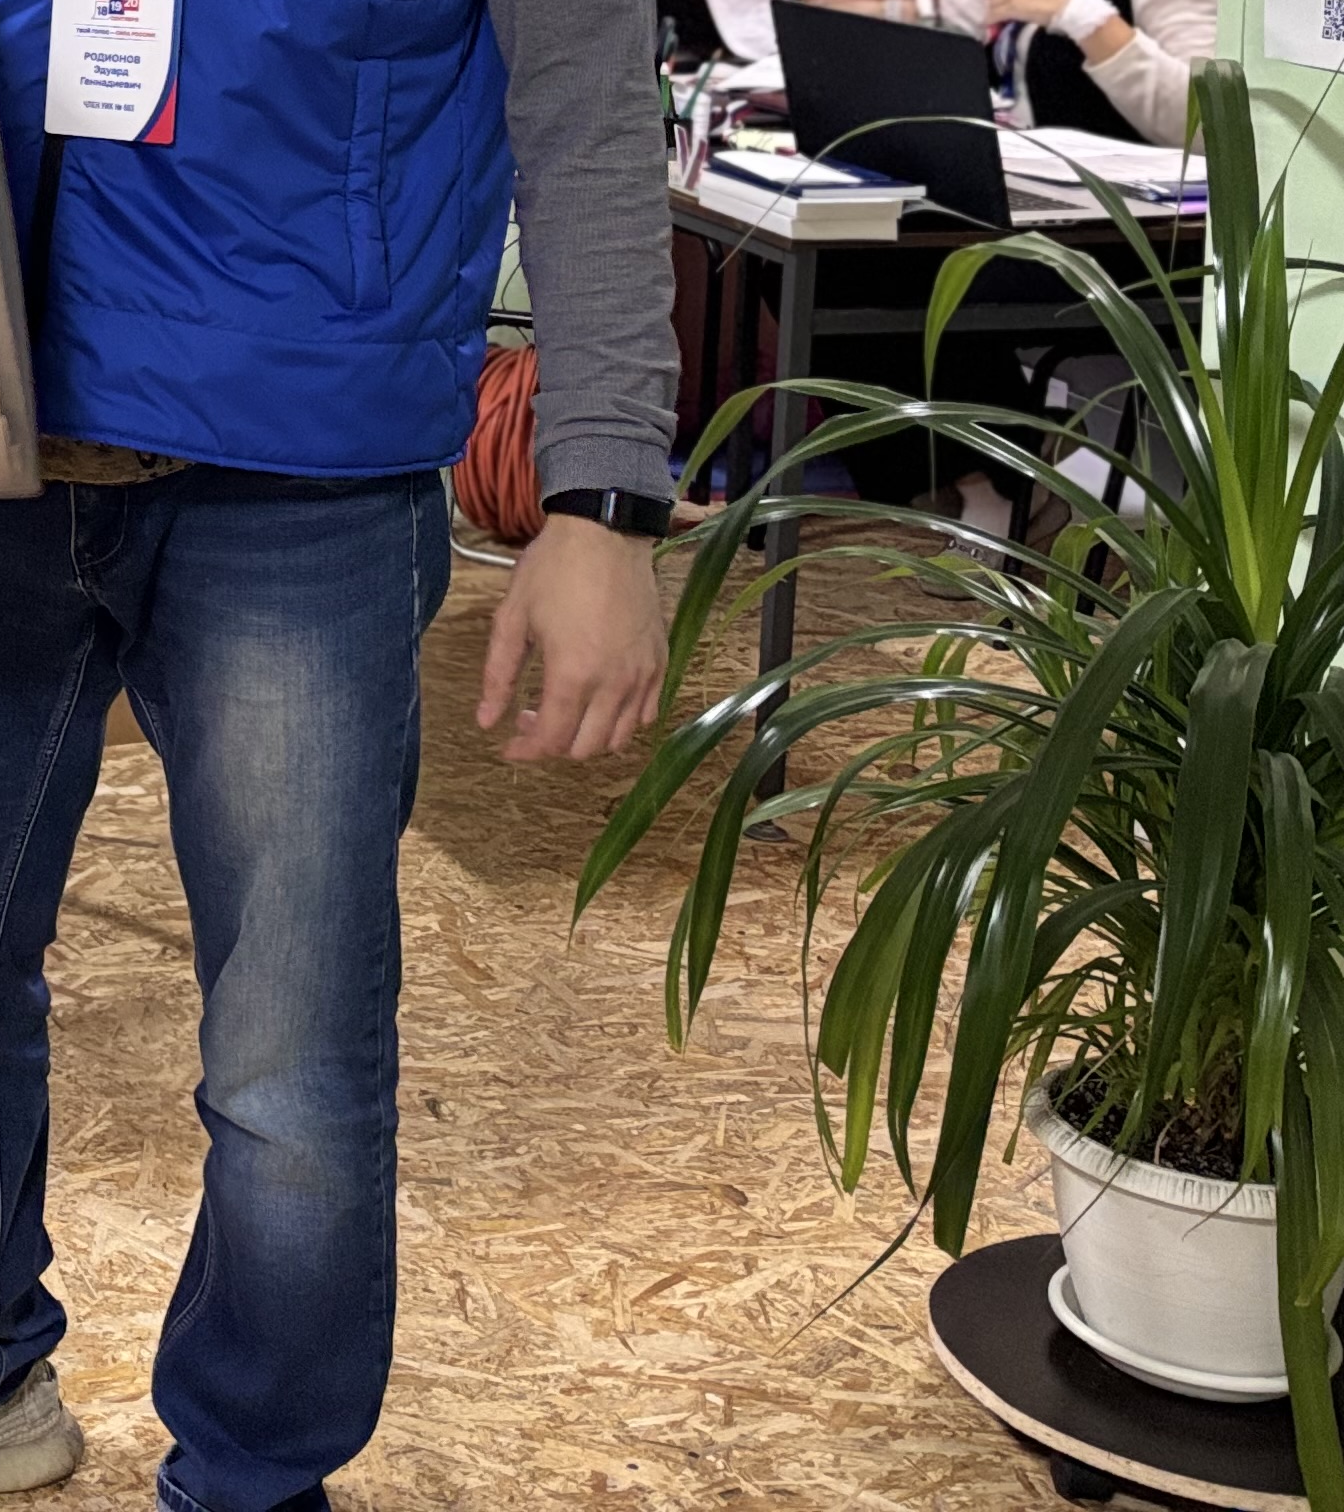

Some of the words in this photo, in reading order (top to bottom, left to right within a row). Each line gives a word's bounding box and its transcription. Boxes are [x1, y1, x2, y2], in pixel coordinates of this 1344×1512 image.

[97, 5, 109, 17] 18
[111, 0, 123, 13] 19
[83, 51, 141, 64] РОДИОНОВ
[93, 65, 129, 77] Эдуард
[79, 76, 142, 90] Геннадиевич
